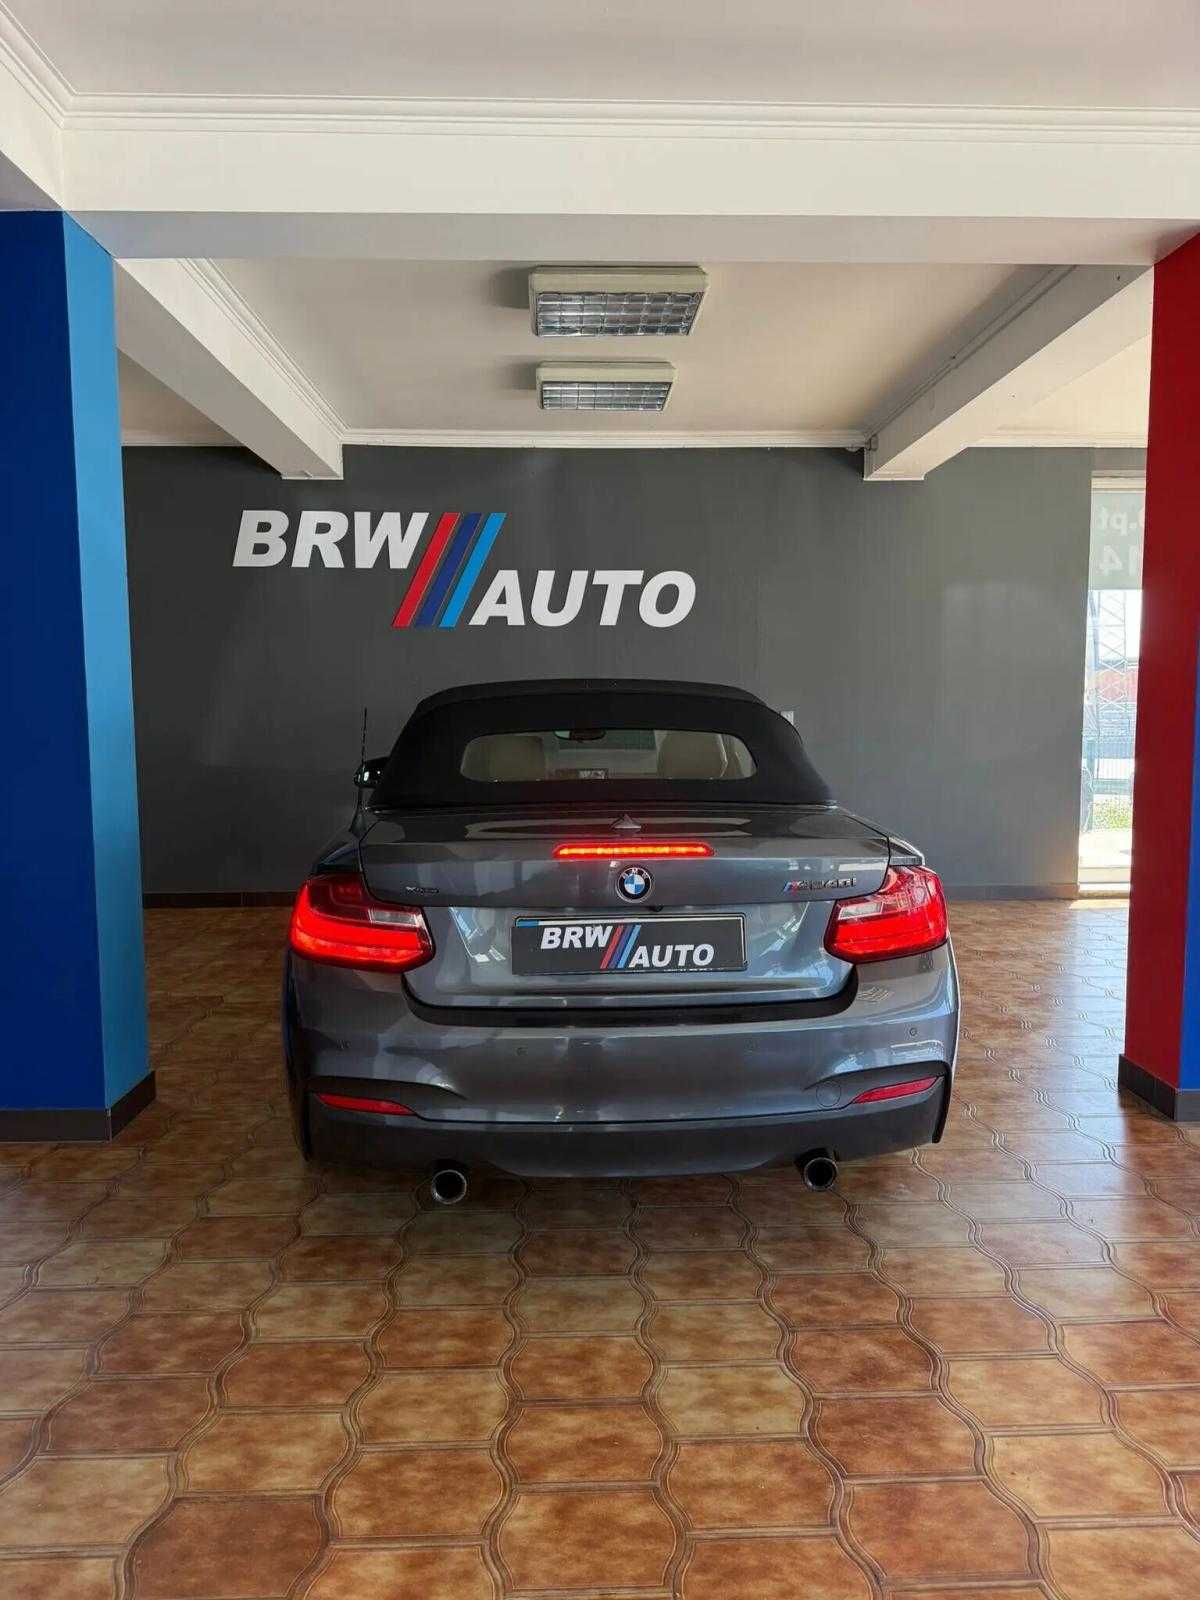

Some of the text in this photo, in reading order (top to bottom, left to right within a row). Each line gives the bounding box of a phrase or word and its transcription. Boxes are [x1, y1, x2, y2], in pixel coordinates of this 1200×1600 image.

[232, 509, 430, 569] BRW
[468, 569, 697, 628] AUTO
[540, 925, 613, 950] BRW
[628, 943, 715, 969] AUTO
